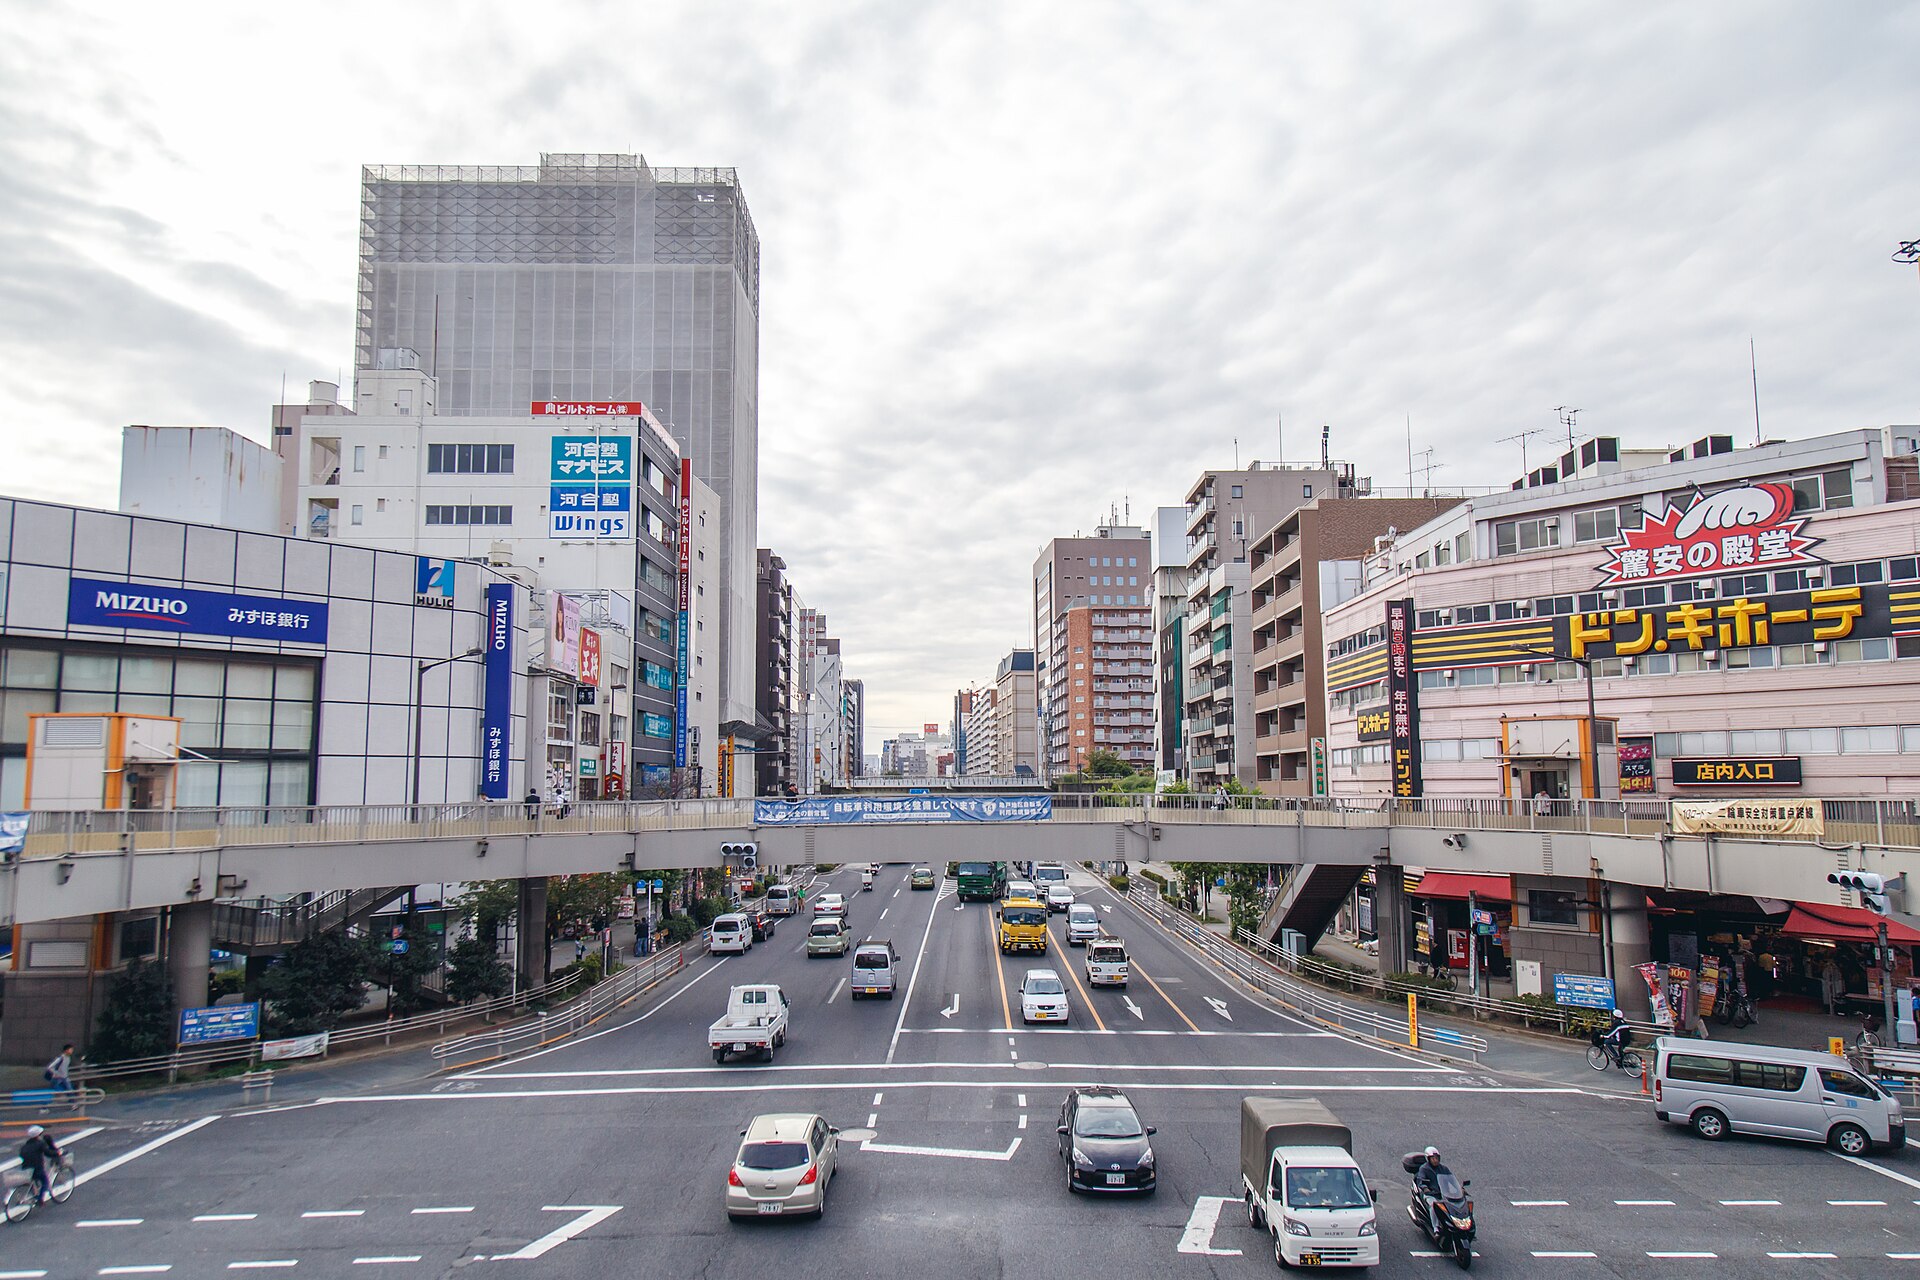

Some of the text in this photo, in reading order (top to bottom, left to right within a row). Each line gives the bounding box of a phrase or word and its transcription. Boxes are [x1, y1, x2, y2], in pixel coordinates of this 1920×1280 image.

[564, 442, 619, 457] 河合塾
[556, 459, 625, 474] マナビス
[560, 493, 620, 507] 河合塾
[555, 515, 624, 535] Wings
[1619, 529, 1794, 579] 驚安の殿堂
[95, 591, 310, 629] MIZUHO みずほ銀行
[416, 595, 454, 608] HULIC
[1391, 607, 1406, 678] 早朝5時まで
[488, 599, 508, 782] MIZUHO みずほ銀行
[1394, 691, 1409, 737] 年中無休
[1696, 763, 1774, 780] 店内入口
[834, 801, 977, 813] 自転車利用環境を整備しています
[1717, 806, 1814, 820] 二輪車安全対策重点路線
